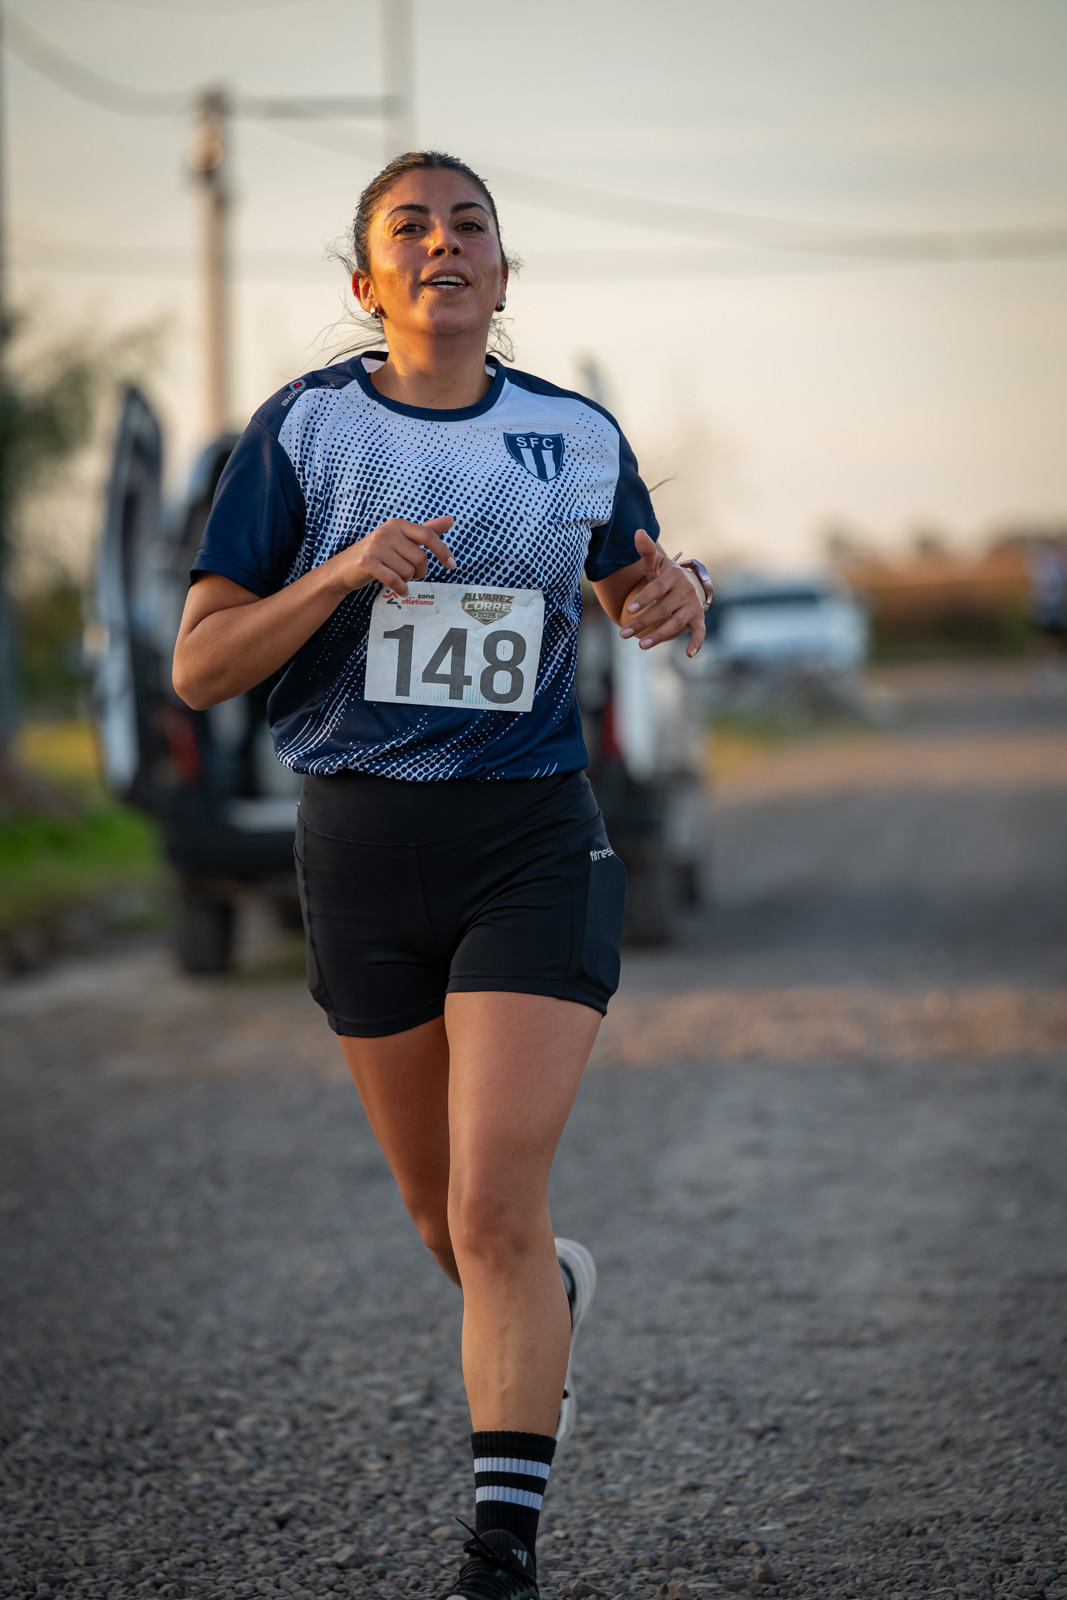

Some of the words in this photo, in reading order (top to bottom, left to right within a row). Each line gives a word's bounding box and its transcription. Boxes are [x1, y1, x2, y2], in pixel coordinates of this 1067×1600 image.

[516, 436, 554, 449] SFC
[401, 598, 434, 606] atletismo
[462, 593, 515, 604] ALVAREZ
[463, 601, 512, 612] CORRE
[383, 624, 527, 705] 148
